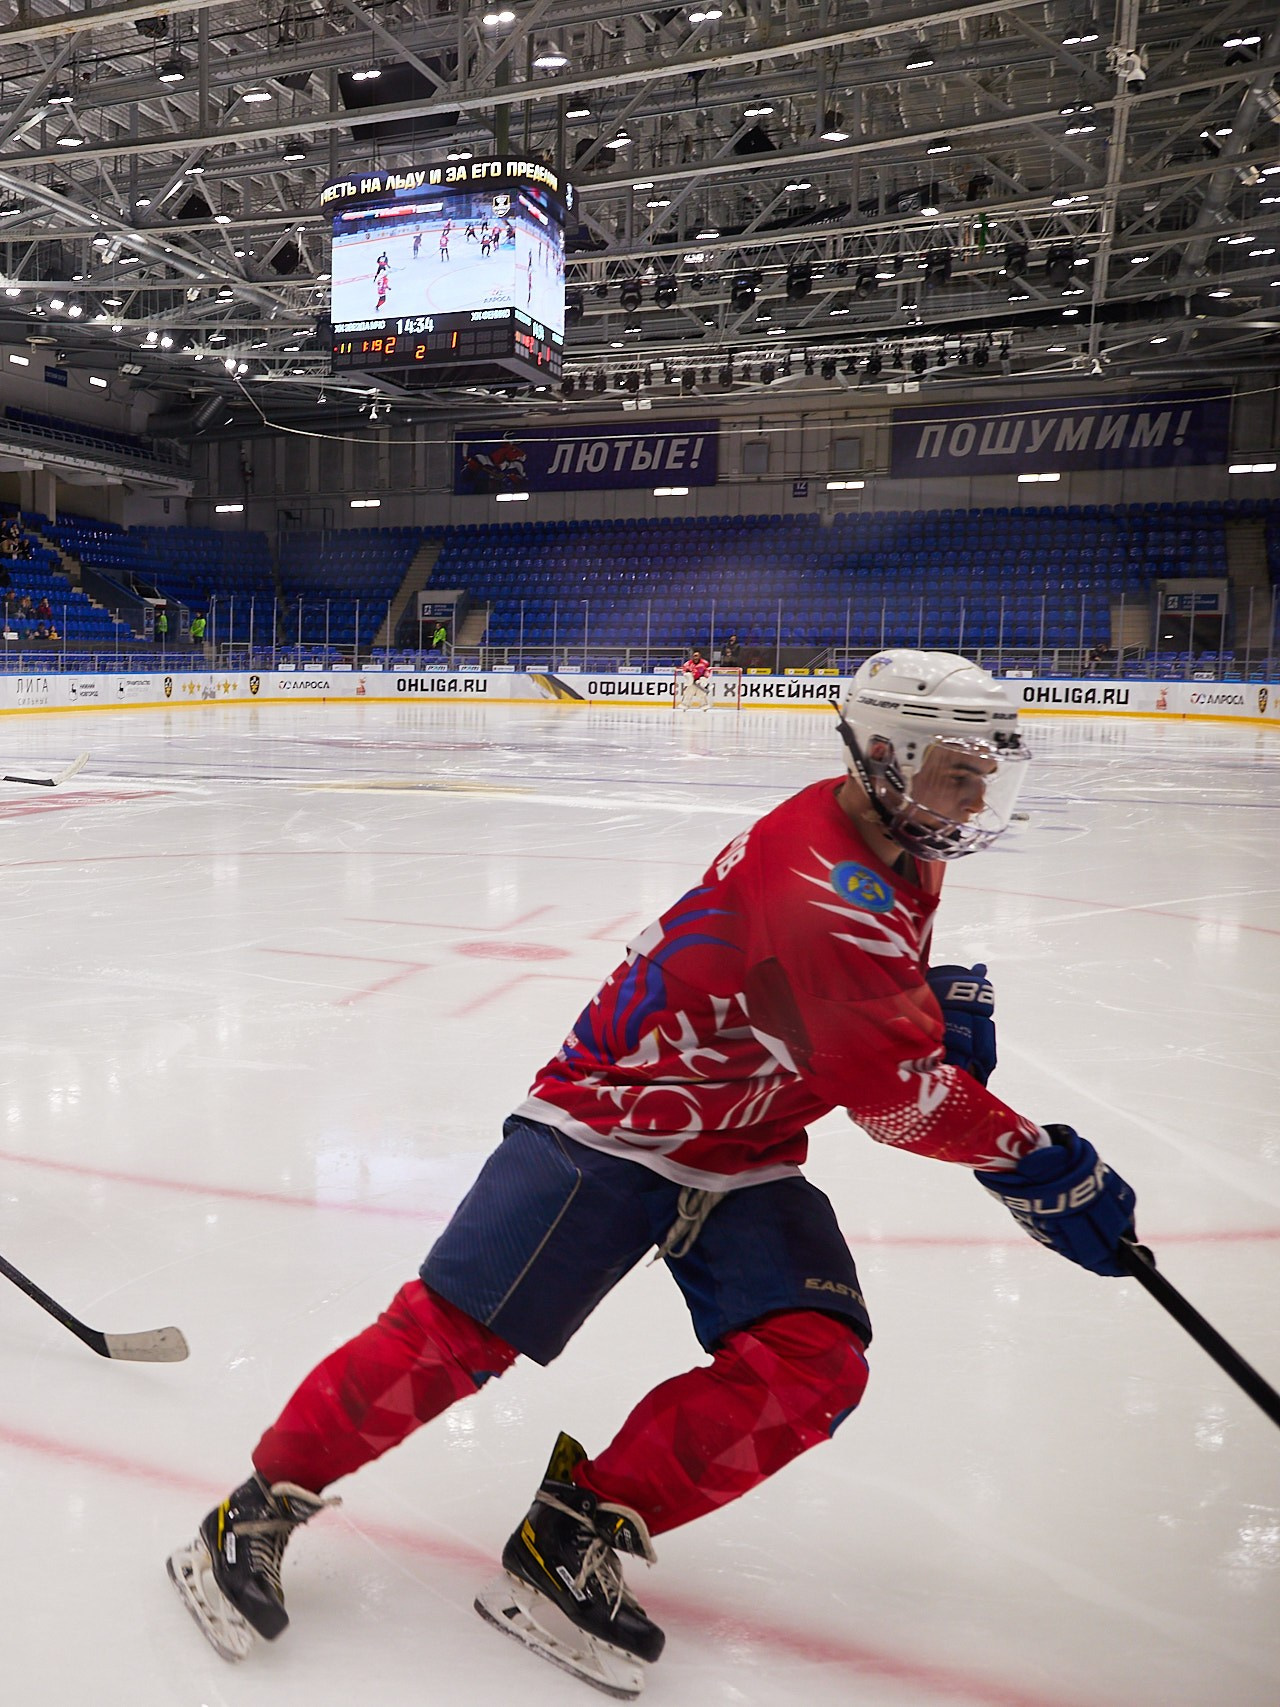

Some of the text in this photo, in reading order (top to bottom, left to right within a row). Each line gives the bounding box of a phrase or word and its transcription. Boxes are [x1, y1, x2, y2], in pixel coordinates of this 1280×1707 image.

[360, 178, 381, 194] НА
[385, 170, 426, 191] ЛЬДУ
[429, 168, 441, 185] И
[445, 165, 467, 183] ЗА
[471, 161, 502, 178] ЕГО
[396, 316, 435, 335] 14:34
[340, 343, 352, 354] 11
[384, 336, 397, 354] 2
[451, 331, 458, 348] 1
[415, 345, 426, 360] 2
[915, 409, 1193, 459] ПОШУМИМ!
[547, 437, 704, 475] ЛЮТЫЕ!
[16, 678, 49, 694] ЛИГА
[396, 678, 488, 693] OHLIGA.RU
[723, 679, 841, 699] ХОККЕЙНАЯ
[1023, 686, 1130, 705] OHLIGA.RU
